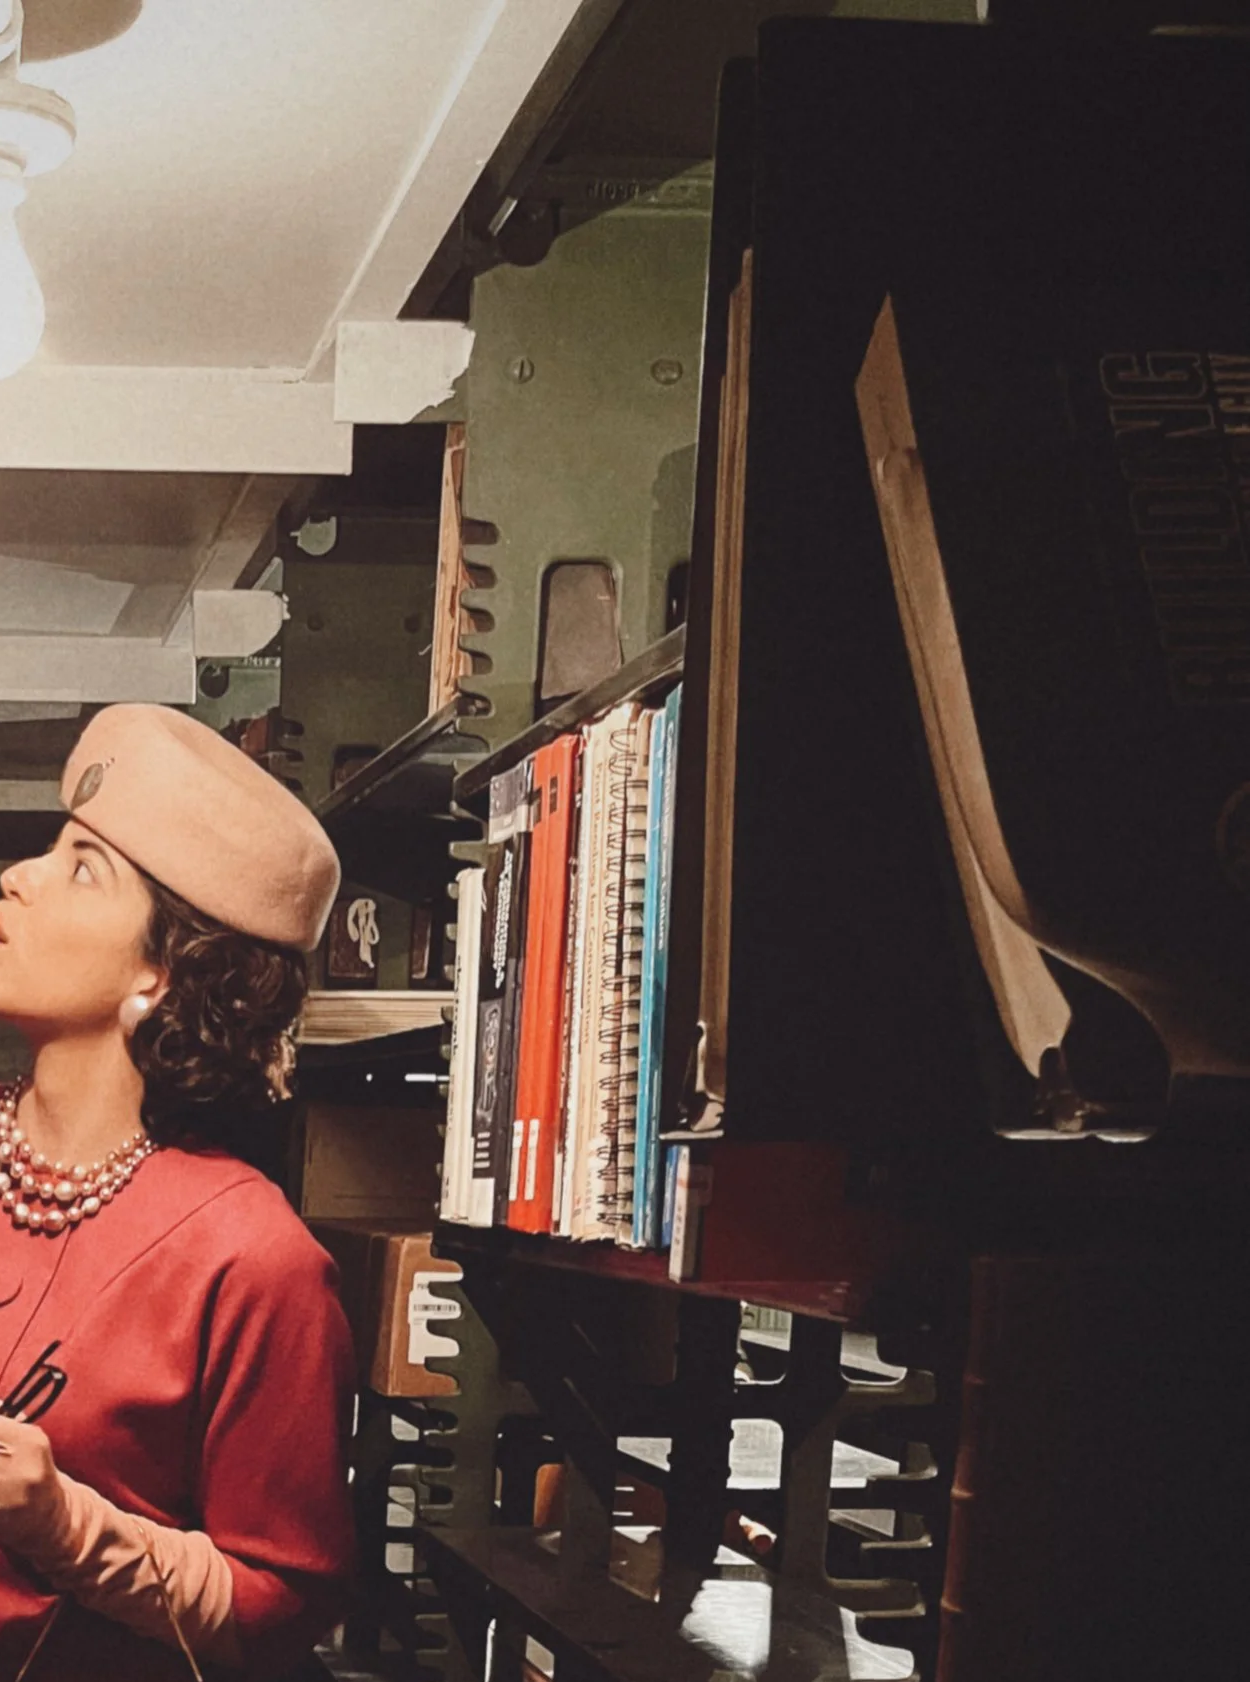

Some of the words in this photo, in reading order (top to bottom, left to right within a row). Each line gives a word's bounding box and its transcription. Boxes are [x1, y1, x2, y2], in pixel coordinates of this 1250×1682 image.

[594, 761, 604, 804] Print
[662, 719, 676, 847] Construction
[588, 810, 602, 887] Reading
[657, 881, 669, 950] Culture
[583, 925, 597, 1046] Construction
